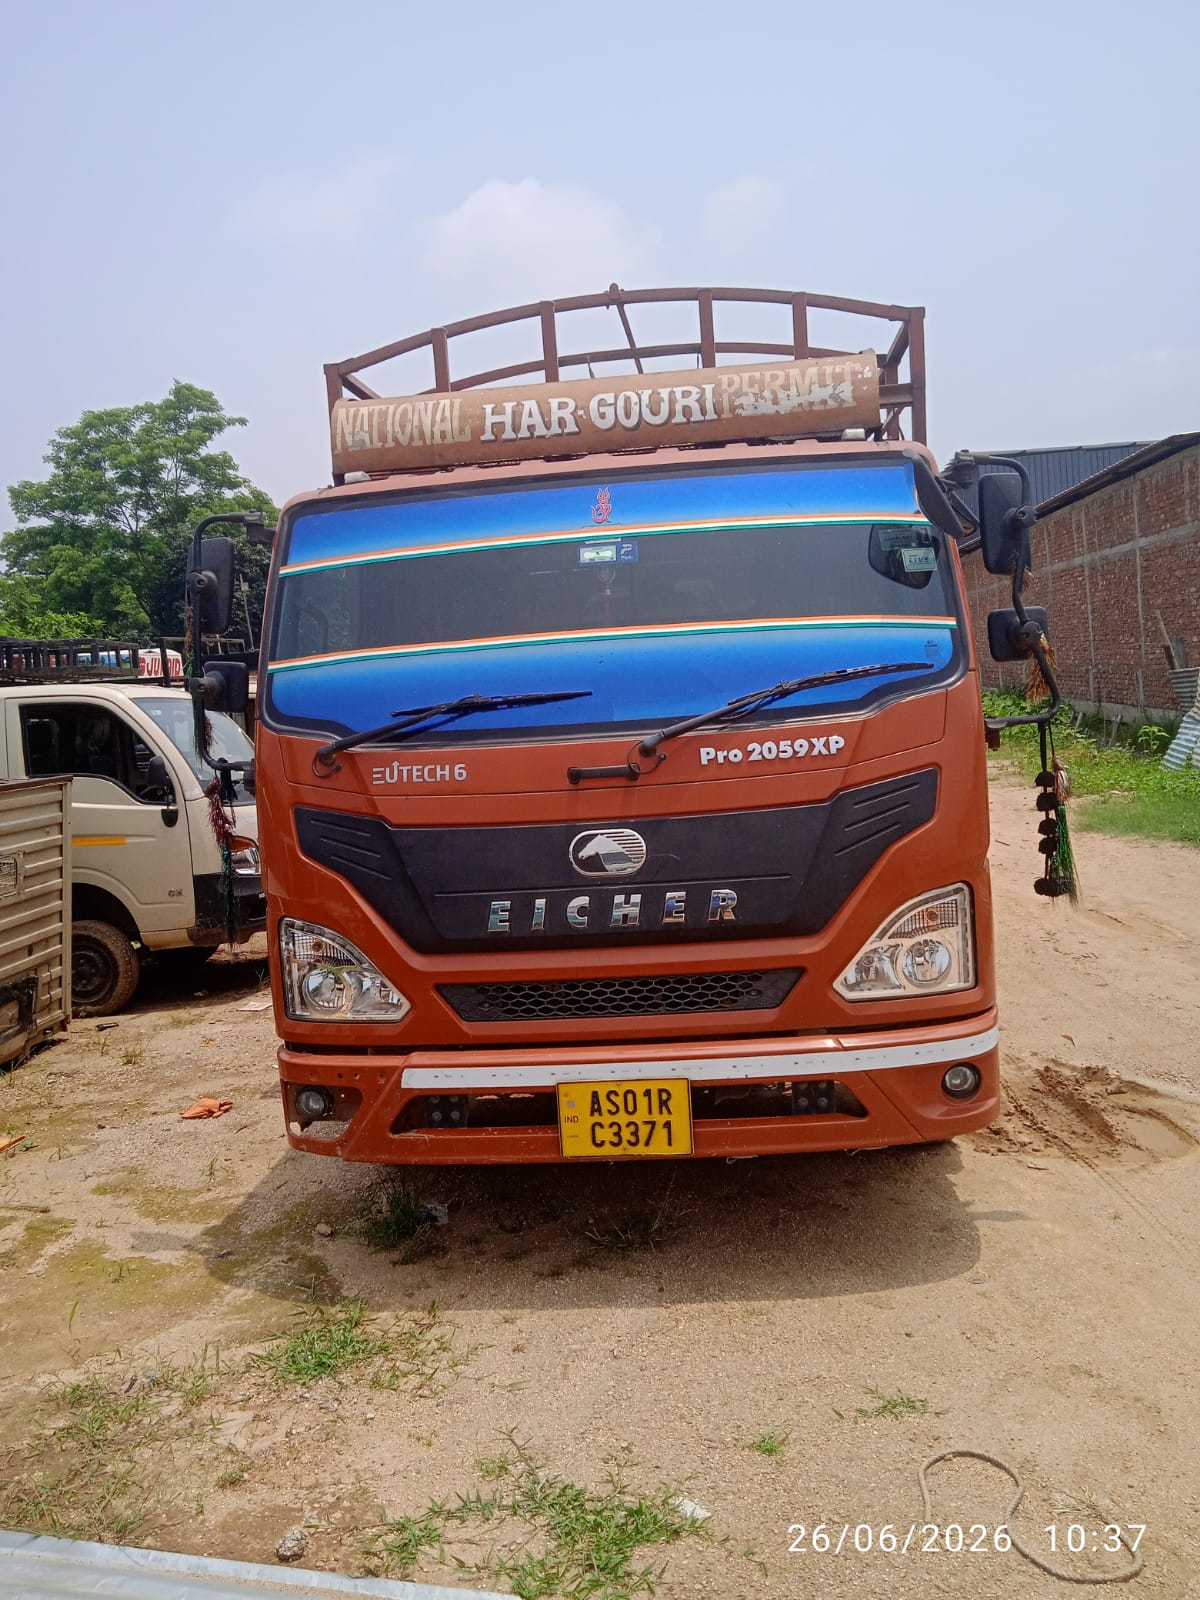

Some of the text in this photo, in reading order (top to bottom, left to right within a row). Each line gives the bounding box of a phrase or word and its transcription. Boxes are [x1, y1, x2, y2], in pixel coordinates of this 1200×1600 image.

[335, 398, 472, 454] NATIONAL
[700, 735, 845, 766] Pro 2059XP
[372, 761, 449, 784] EUTECH
[487, 888, 738, 932] EICHER
[590, 1088, 673, 1117] AS01R
[564, 1115, 579, 1124] IND
[591, 1120, 673, 1148] C3371
